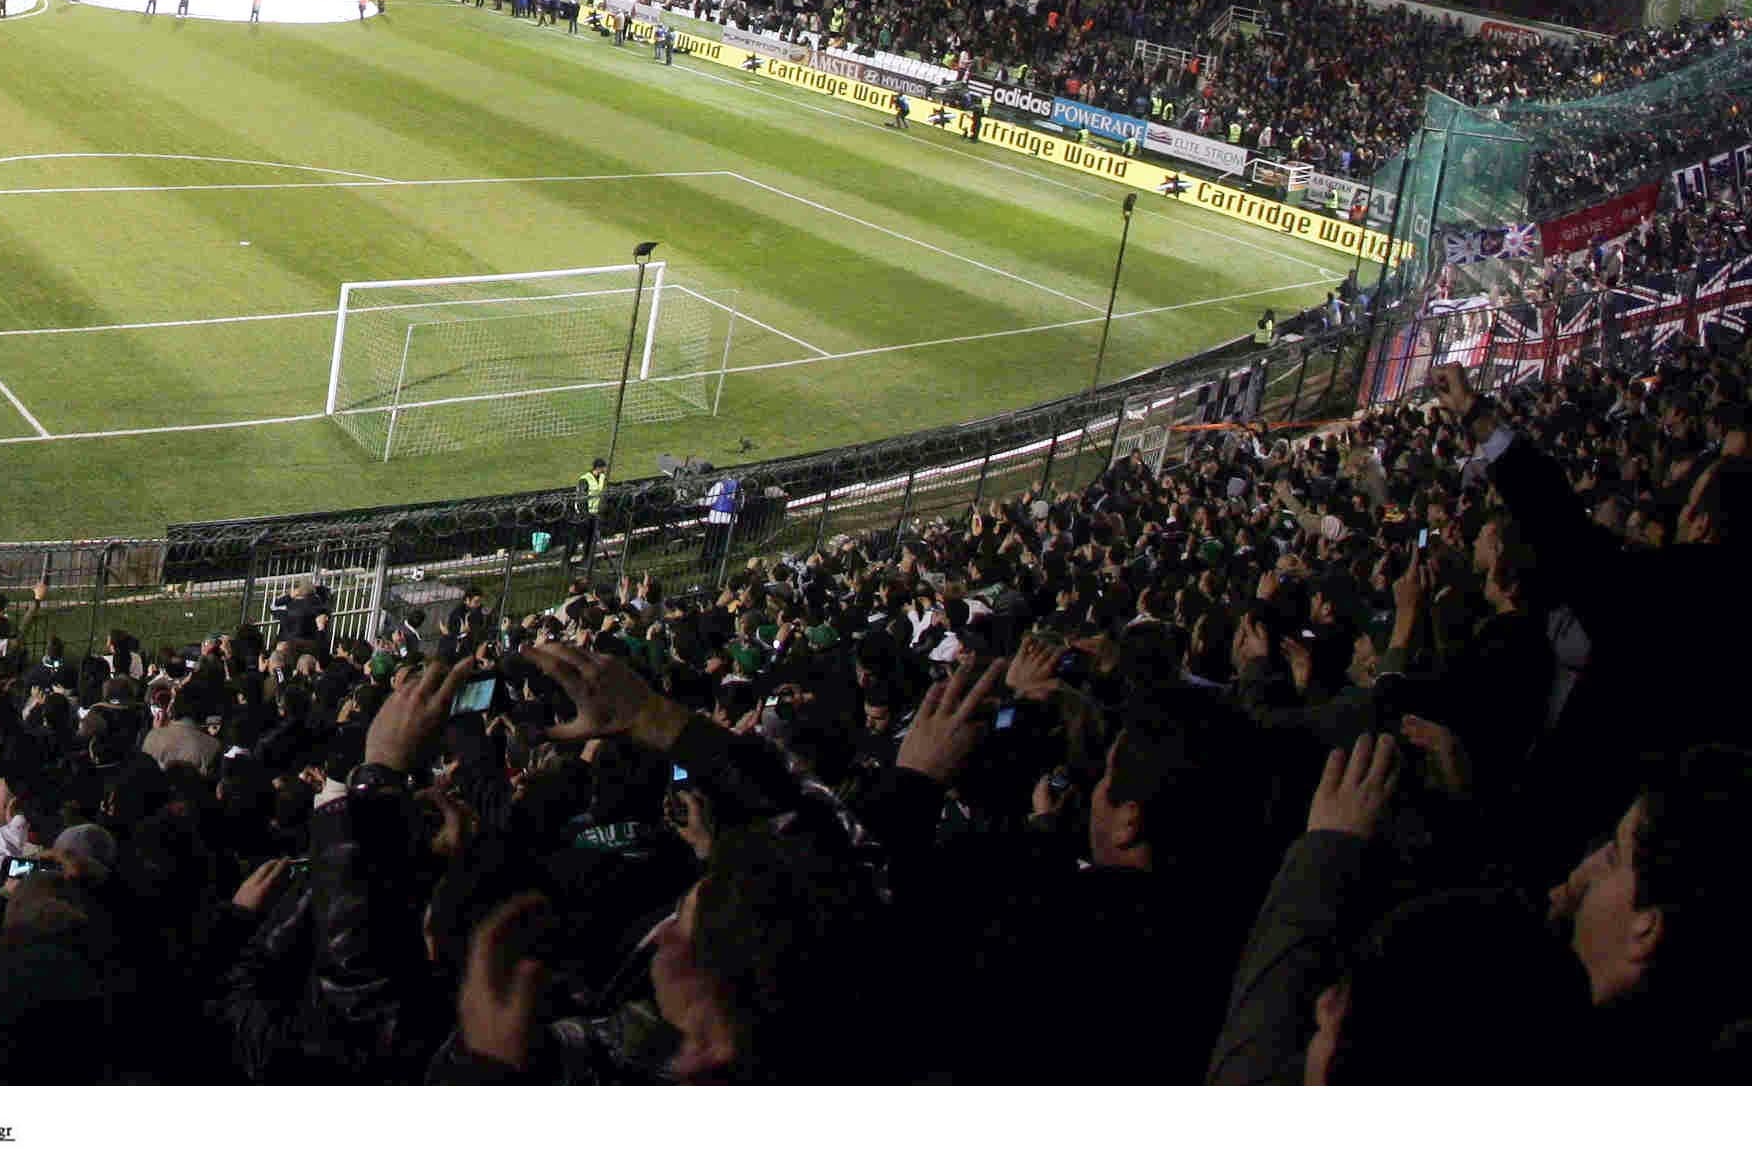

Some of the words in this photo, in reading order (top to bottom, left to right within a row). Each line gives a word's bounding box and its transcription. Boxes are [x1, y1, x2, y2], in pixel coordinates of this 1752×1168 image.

[677, 33, 721, 59] World
[768, 58, 847, 98] Cartridge
[809, 57, 858, 79] AMSTEL
[994, 87, 1052, 116] adidas
[1054, 102, 1146, 140] POWERADE
[958, 112, 1055, 157] Crtridge
[1064, 144, 1128, 178] World
[1174, 137, 1200, 155] ELITE
[1196, 181, 1312, 234] Cartridge
